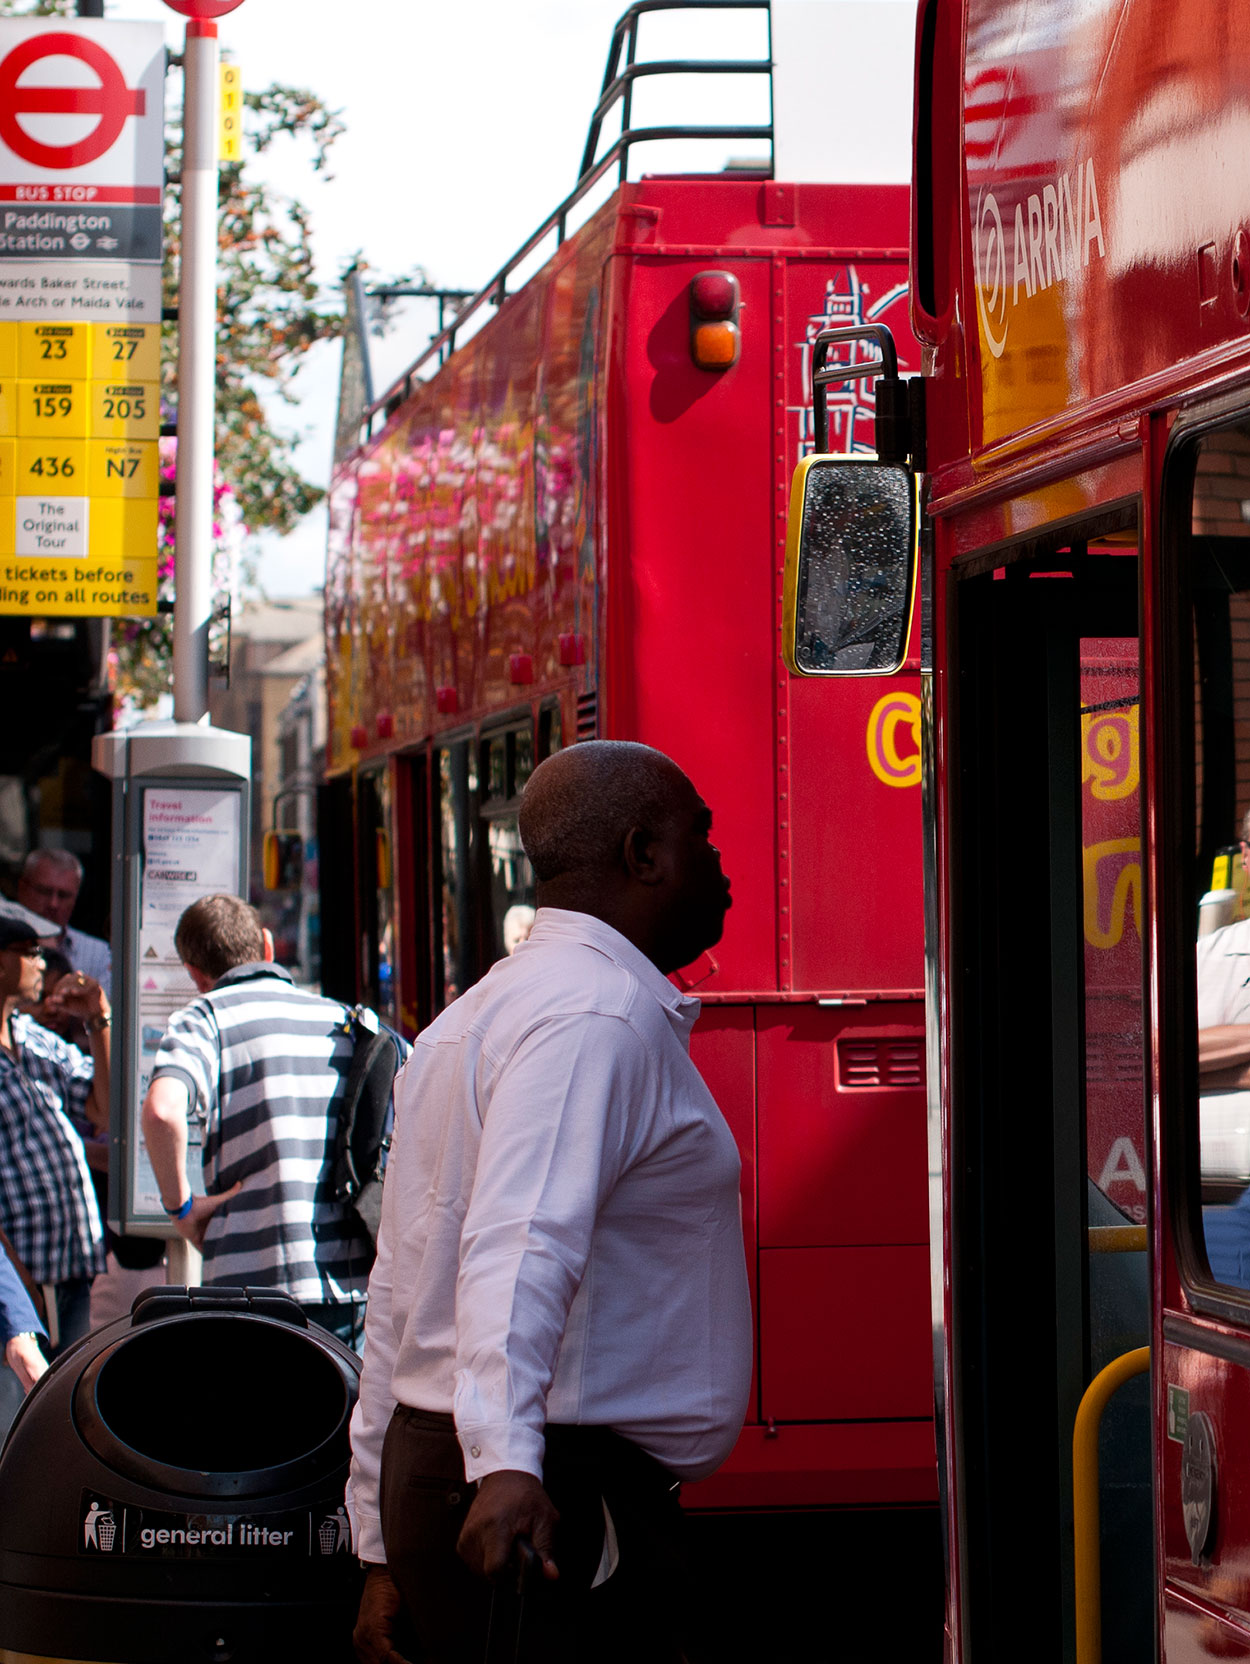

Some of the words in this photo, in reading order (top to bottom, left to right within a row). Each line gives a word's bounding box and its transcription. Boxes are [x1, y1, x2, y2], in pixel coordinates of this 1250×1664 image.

[15, 186, 49, 201] BUS
[53, 186, 98, 201] STOP
[4, 211, 111, 233] Paddington
[1013, 157, 1106, 307] ARRIVA
[0, 233, 64, 250] Station
[40, 277, 77, 289] Baker
[15, 296, 47, 307] Arch
[51, 298, 66, 308] or
[71, 296, 110, 309] Maida
[115, 297, 145, 309] Vale
[41, 339, 67, 359] 23
[112, 341, 139, 360] 27
[33, 397, 73, 417] 159
[103, 399, 146, 419] 205
[29, 457, 75, 478] 436
[107, 459, 141, 478] N7
[39, 502, 65, 515] The
[23, 519, 79, 534] Original
[36, 535, 67, 548] Tour
[5, 567, 68, 582] tickets
[74, 567, 134, 583] before
[35, 591, 58, 603] on
[65, 588, 85, 603] all
[92, 591, 150, 604] routes
[150, 799, 182, 811] Travel
[149, 813, 213, 824] information
[140, 1523, 234, 1548] general
[239, 1524, 294, 1546] litter
